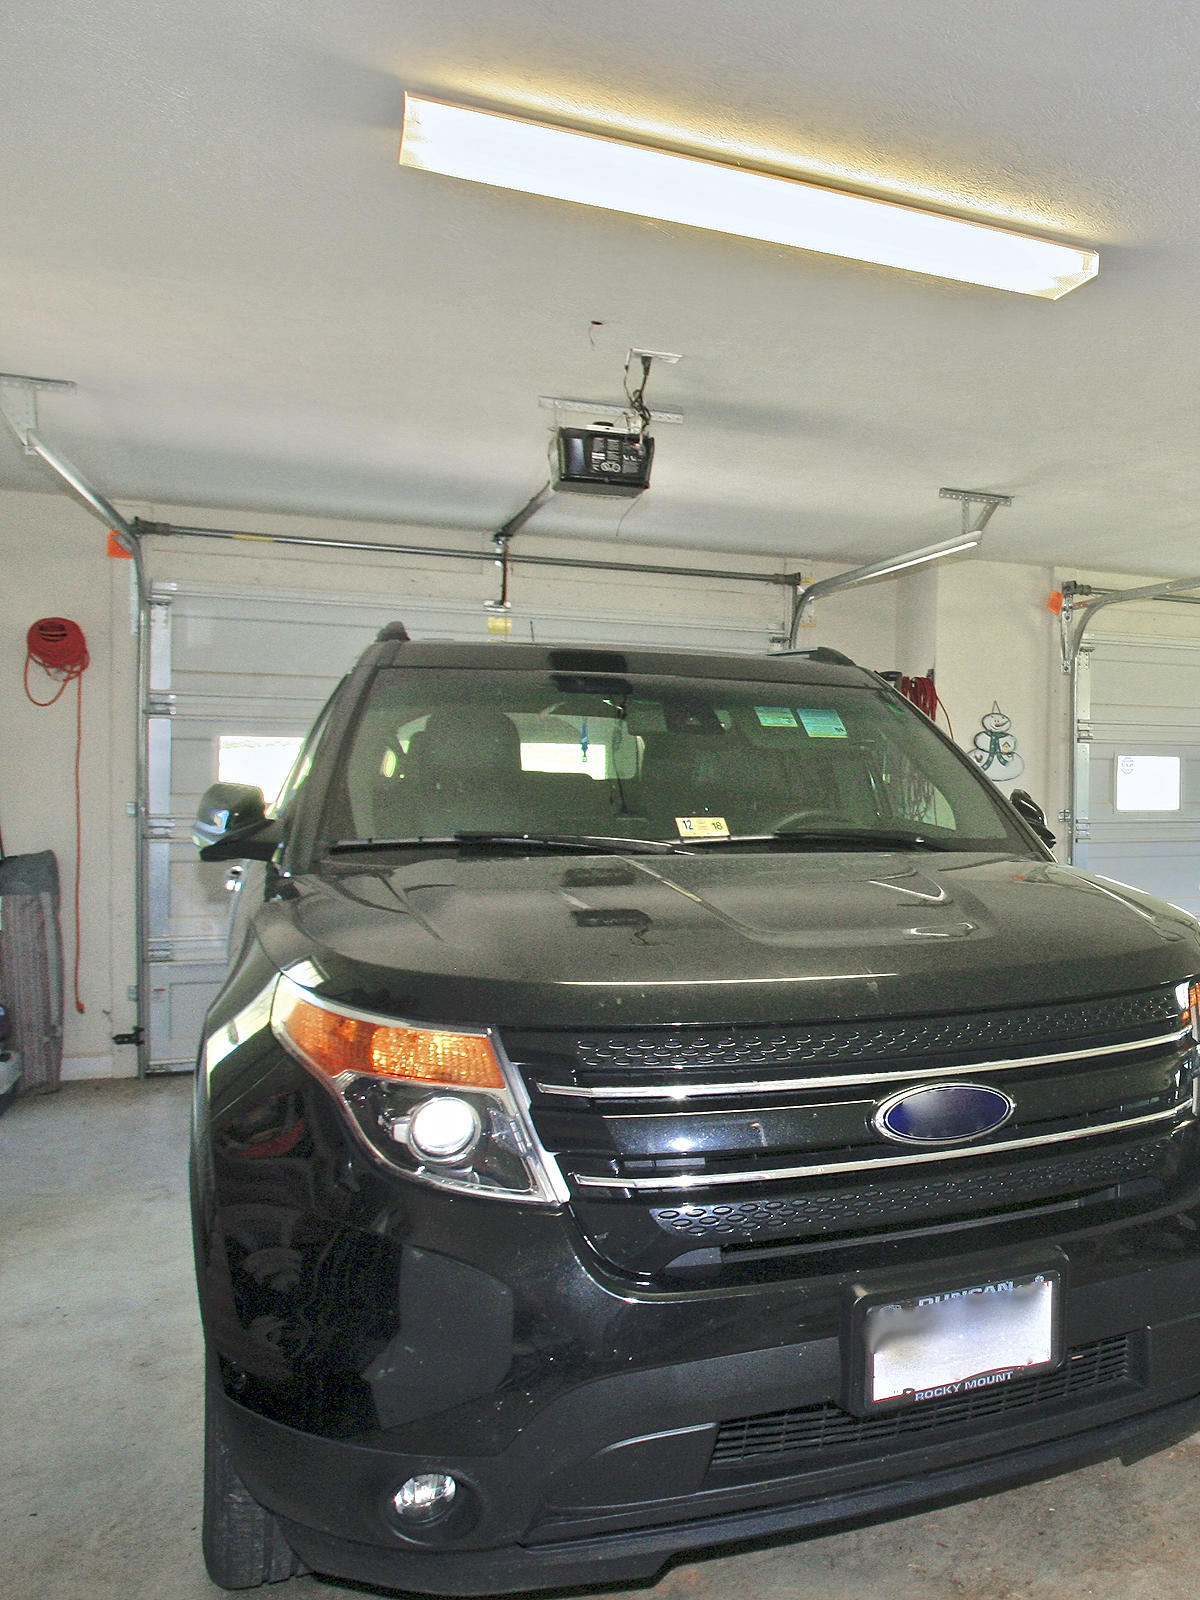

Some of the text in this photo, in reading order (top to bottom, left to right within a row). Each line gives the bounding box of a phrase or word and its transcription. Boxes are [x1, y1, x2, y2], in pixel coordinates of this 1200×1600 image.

[682, 820, 694, 830] 12
[712, 821, 723, 830] 18
[914, 1371, 1014, 1401] ROCKY MOUNT
